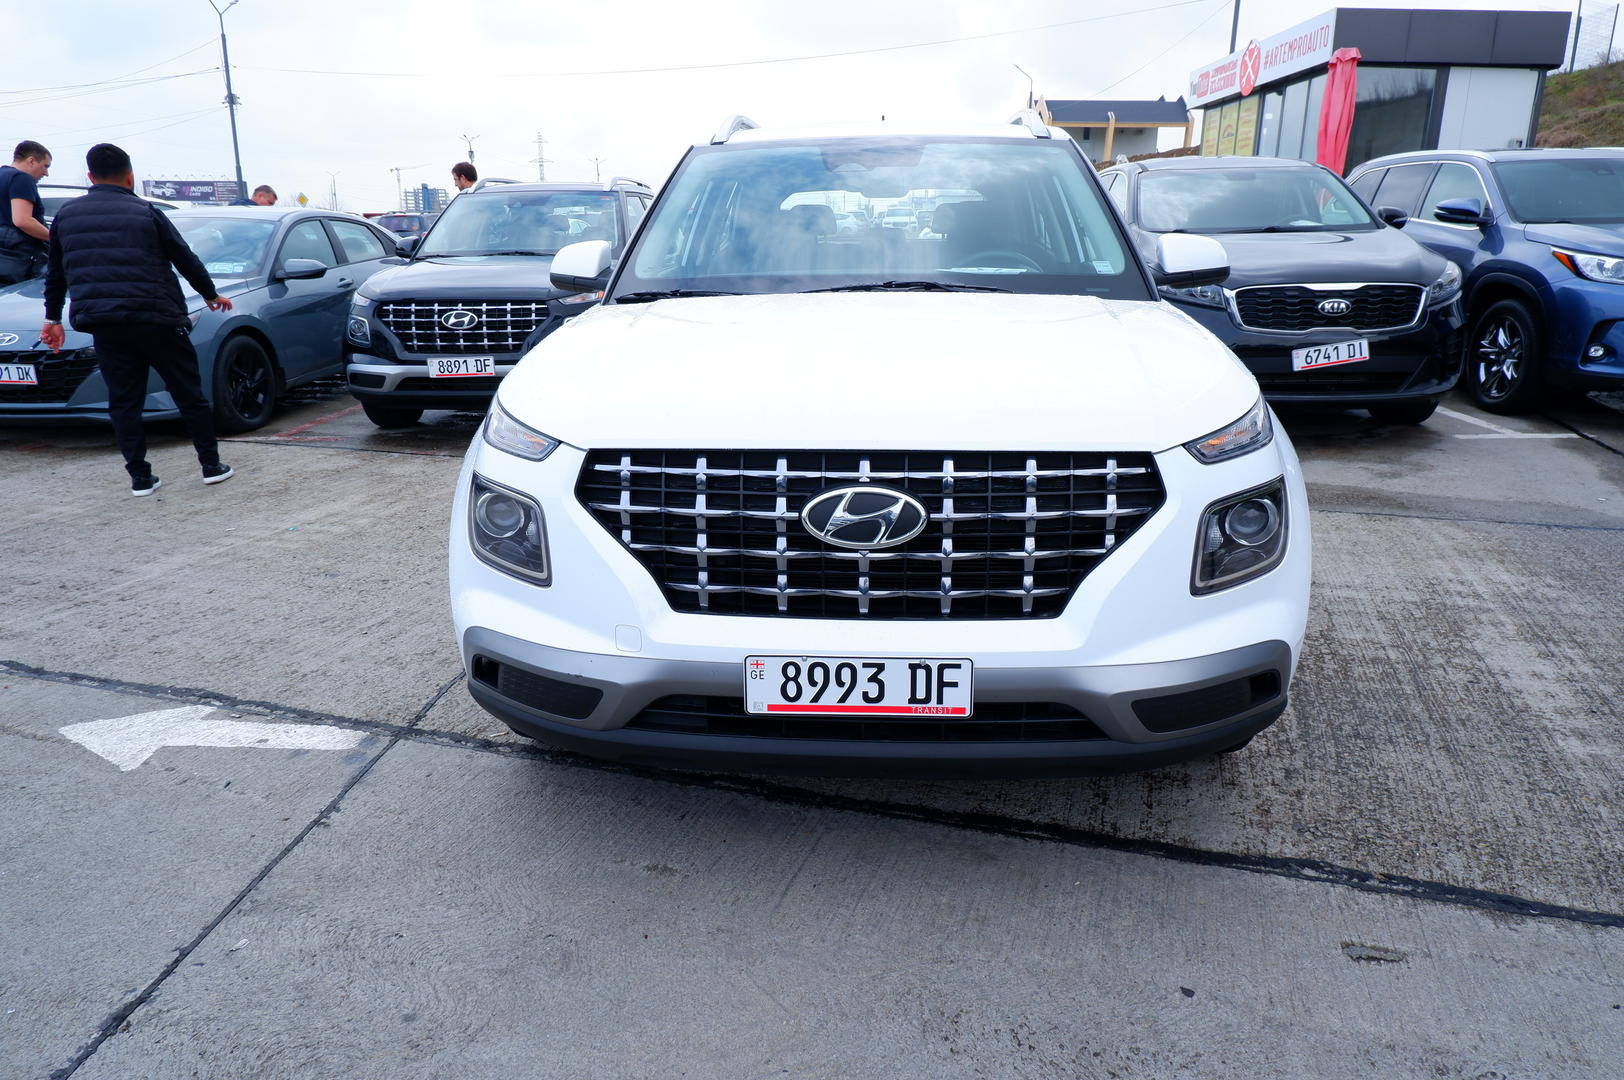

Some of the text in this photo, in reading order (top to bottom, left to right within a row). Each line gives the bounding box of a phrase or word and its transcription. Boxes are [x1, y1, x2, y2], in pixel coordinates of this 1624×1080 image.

[1263, 25, 1330, 70] #ARTEMPROAUTO
[1323, 302, 1347, 313] KIA
[1304, 341, 1363, 365] 6741 DI
[16, 366, 33, 381] DK
[438, 359, 491, 374] 8891 DF
[750, 670, 765, 680] GE
[780, 660, 962, 705] 8993 DF
[911, 706, 953, 715] TRANSIT
